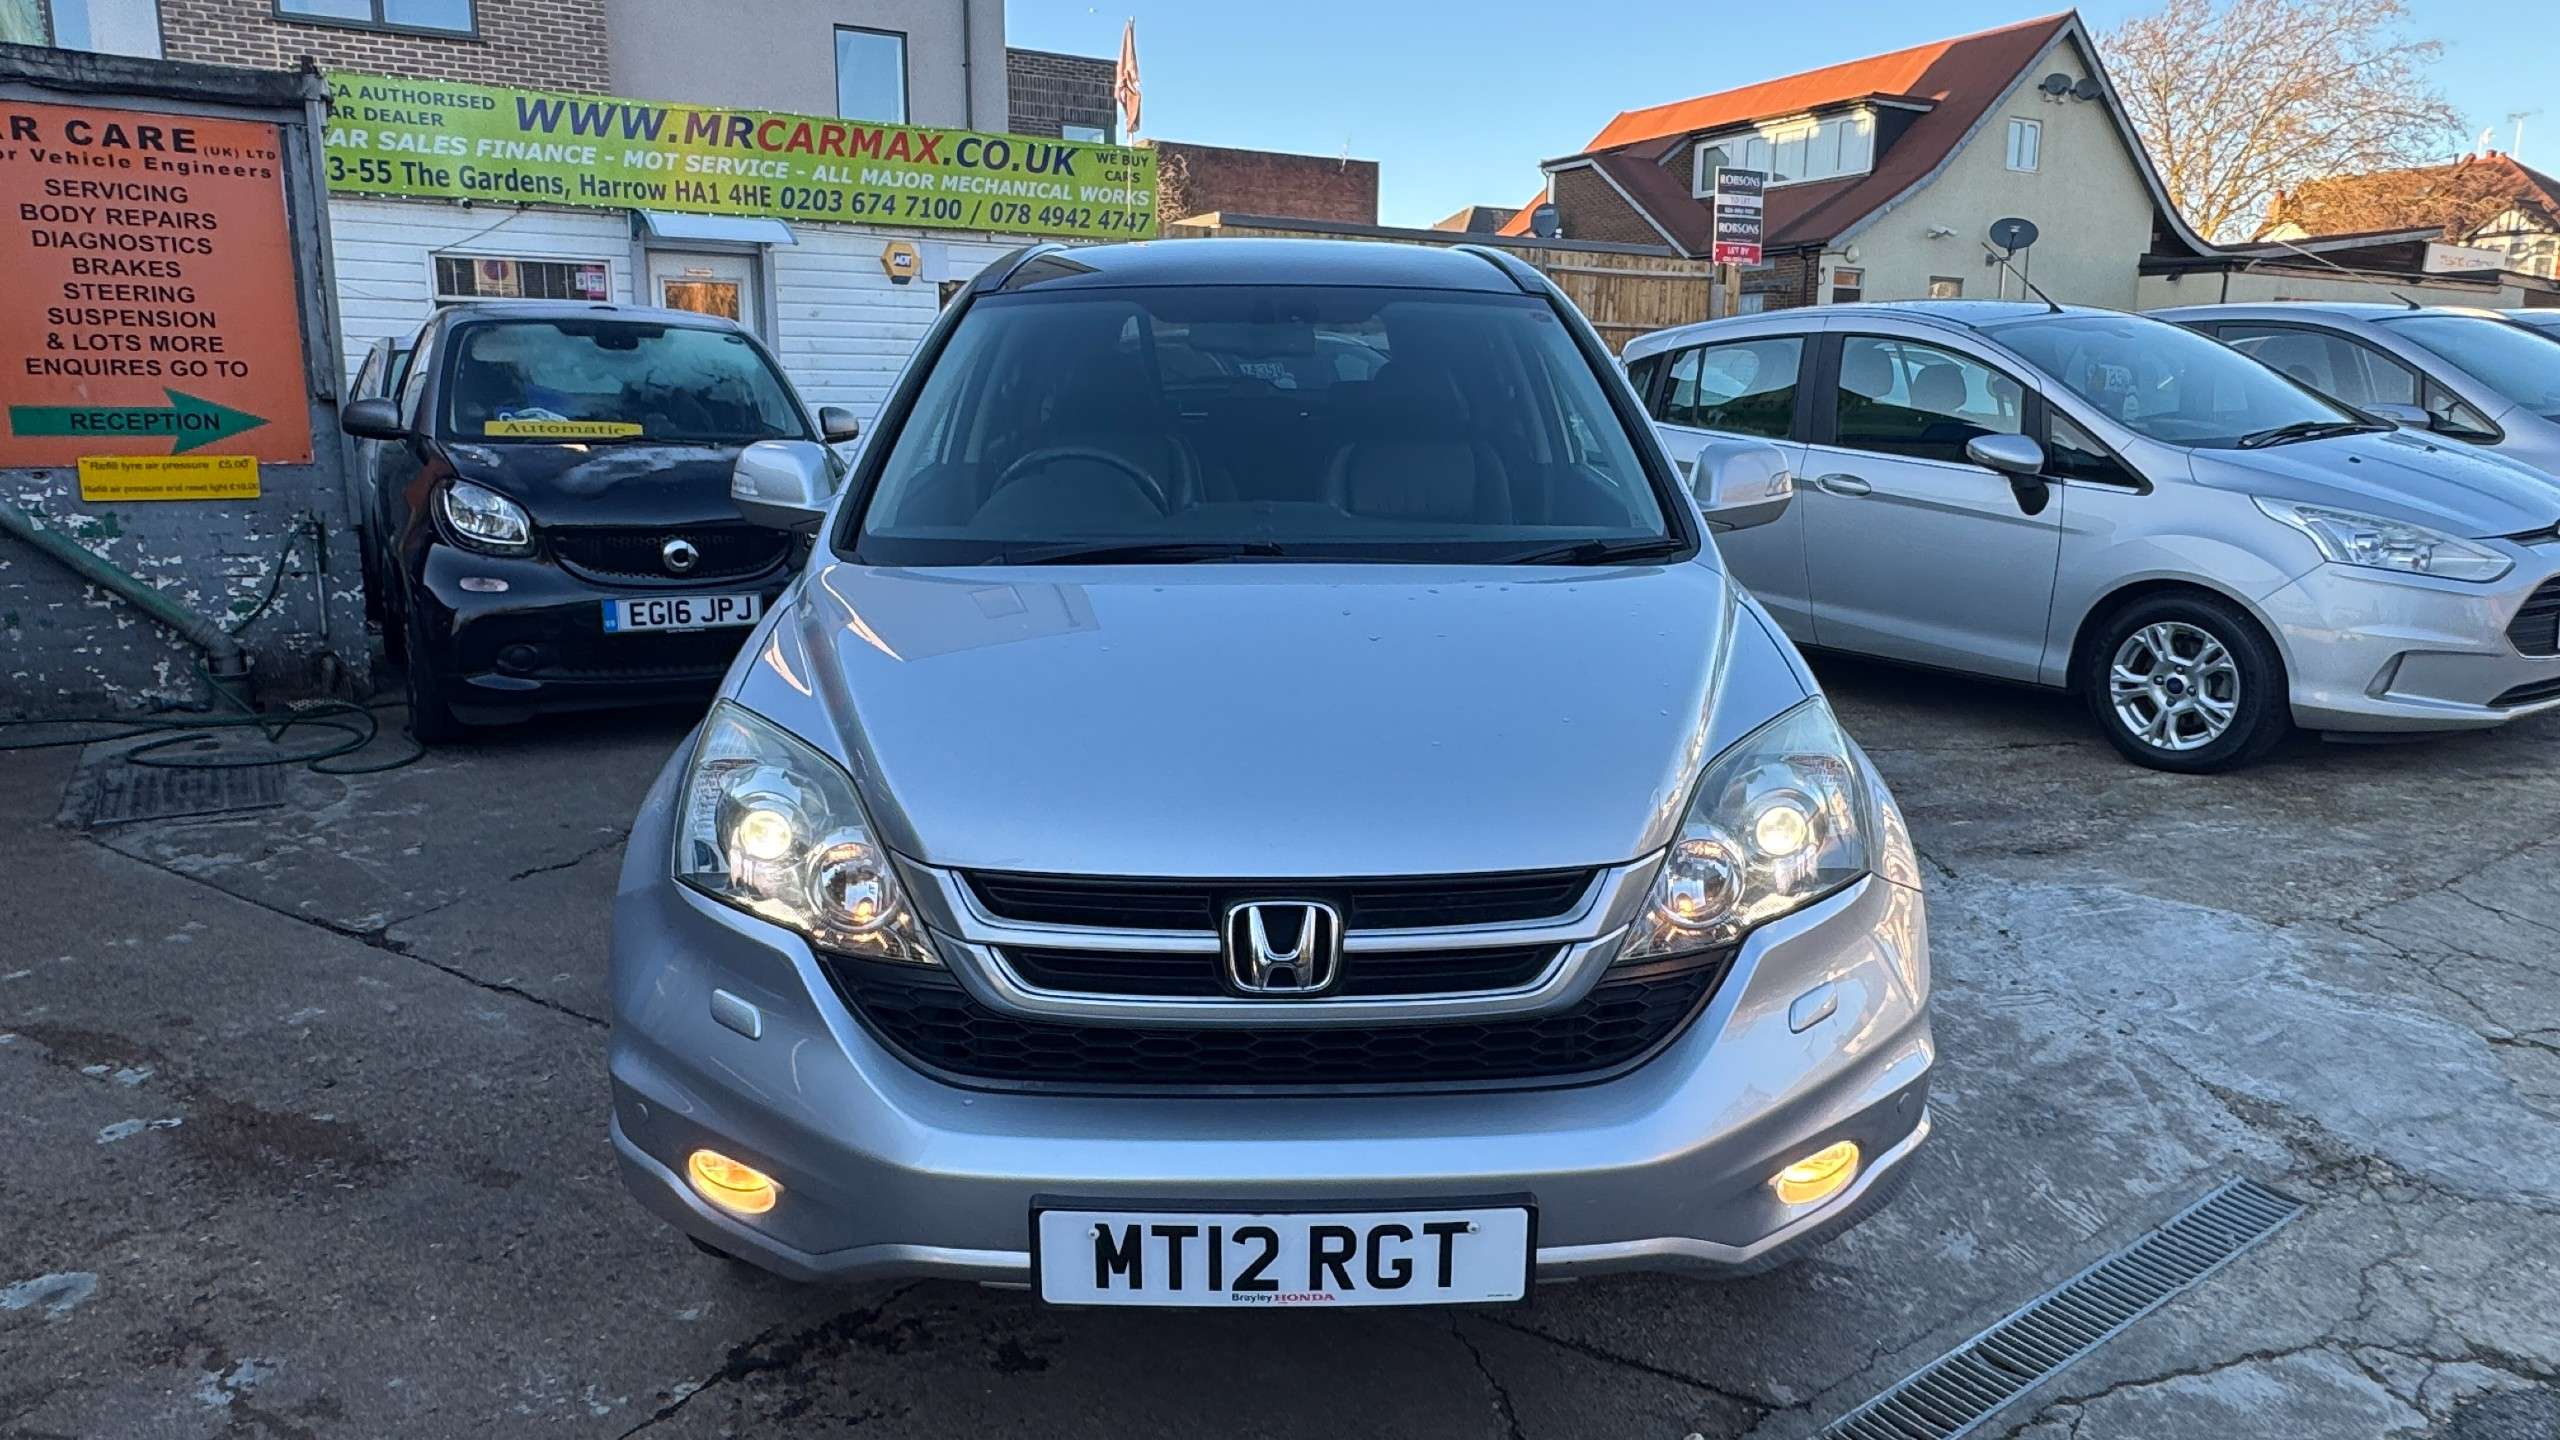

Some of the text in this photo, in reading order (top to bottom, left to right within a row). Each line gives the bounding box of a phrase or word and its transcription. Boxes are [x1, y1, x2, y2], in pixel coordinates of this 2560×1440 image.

[359, 86, 495, 110] AUTHORISED
[364, 107, 444, 126] DEALER
[65, 120, 197, 153] CARE
[203, 146, 240, 159] (UK)
[247, 150, 276, 160] LTD
[516, 97, 1080, 176] WWW.MRCARMAX.CO.UK
[30, 148, 131, 169] Vehicle
[143, 157, 272, 179] Engineers
[378, 130, 468, 156] SALES
[476, 138, 597, 165] FINANCE
[623, 150, 679, 170] MOT
[685, 154, 790, 178] SERVICE
[812, 165, 853, 184] ALL
[860, 168, 934, 190] MAJOR
[941, 175, 1073, 200] MECHANICAL
[1080, 186, 1150, 206] WORKS
[1096, 152, 1149, 167] WE BUY
[44, 179, 189, 203] SERVICING
[400, 161, 450, 187] The
[459, 165, 570, 200] Gardens,
[580, 173, 666, 201] Harrow
[675, 180, 720, 203] HA1
[729, 184, 771, 208] 4HE
[781, 186, 843, 212] 0203
[852, 192, 896, 216] 674
[906, 196, 962, 220] 7100
[990, 202, 1031, 224] 078
[1038, 206, 1091, 229] 4942
[1098, 210, 1150, 232] 4747
[20, 203, 217, 230] BODY REPAIRS
[31, 229, 213, 255] DIAGNOSTICS
[72, 257, 182, 278] BRAKES
[63, 283, 196, 303] STEERING
[47, 307, 216, 328] SUSPENSION
[46, 333, 225, 353] & LOTS MORE
[25, 358, 248, 378] ENQUIRES GO TO
[70, 413, 221, 431] RECEPTION
[504, 423, 626, 435] Automatic
[629, 597, 751, 626] EG16 JPJ
[1094, 1221, 1479, 1292] MT12 RGT
[1232, 1293, 1336, 1304] Brayley HONDA
